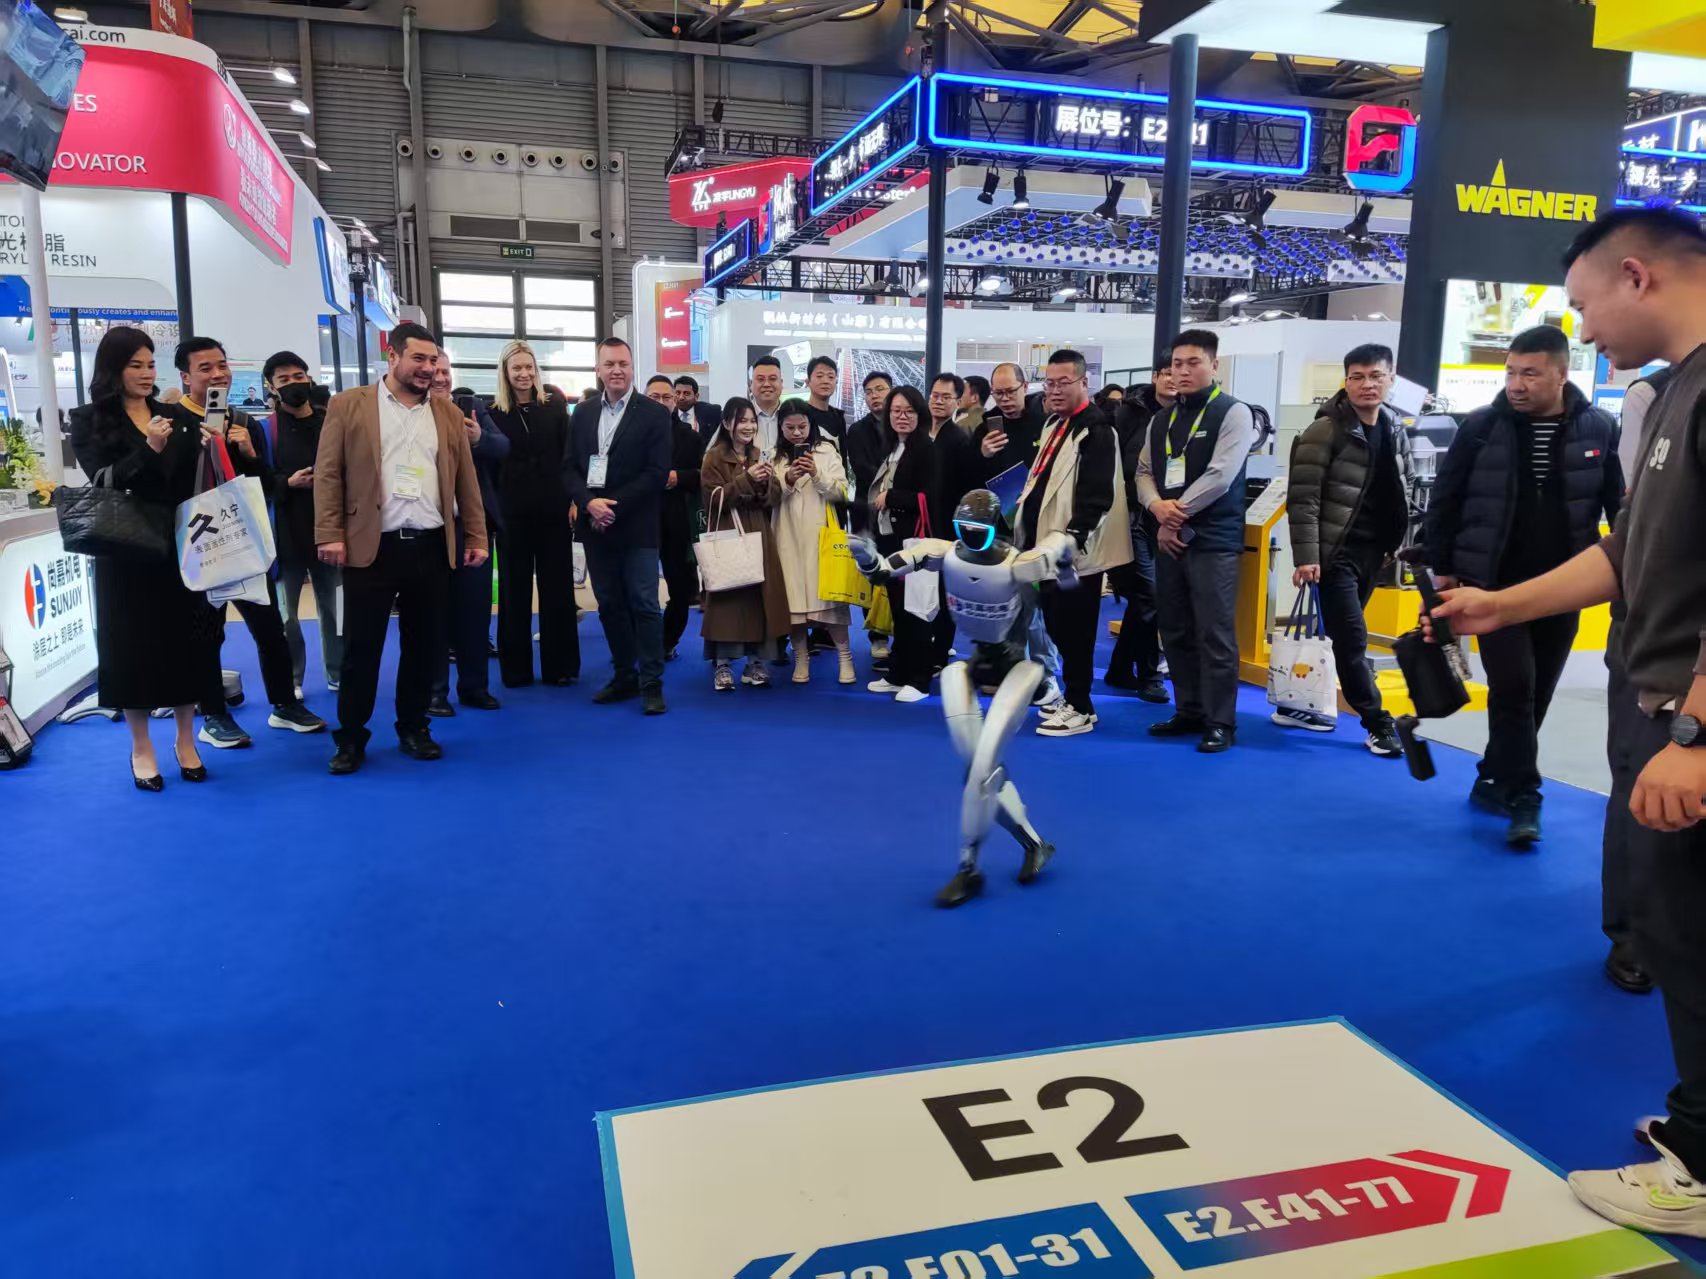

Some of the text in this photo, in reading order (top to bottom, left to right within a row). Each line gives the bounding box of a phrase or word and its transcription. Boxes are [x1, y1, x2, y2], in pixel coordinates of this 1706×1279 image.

[62, 25, 126, 43] ai.com
[72, 94, 97, 112] ES
[52, 151, 147, 173] OVATOR
[1455, 178, 1598, 222] WAGNER
[0, 253, 97, 267] RYL RESIN
[50, 585, 82, 618] SUNJOY
[922, 1076, 1190, 1181] E2
[1165, 1176, 1414, 1244] E2.E41-77
